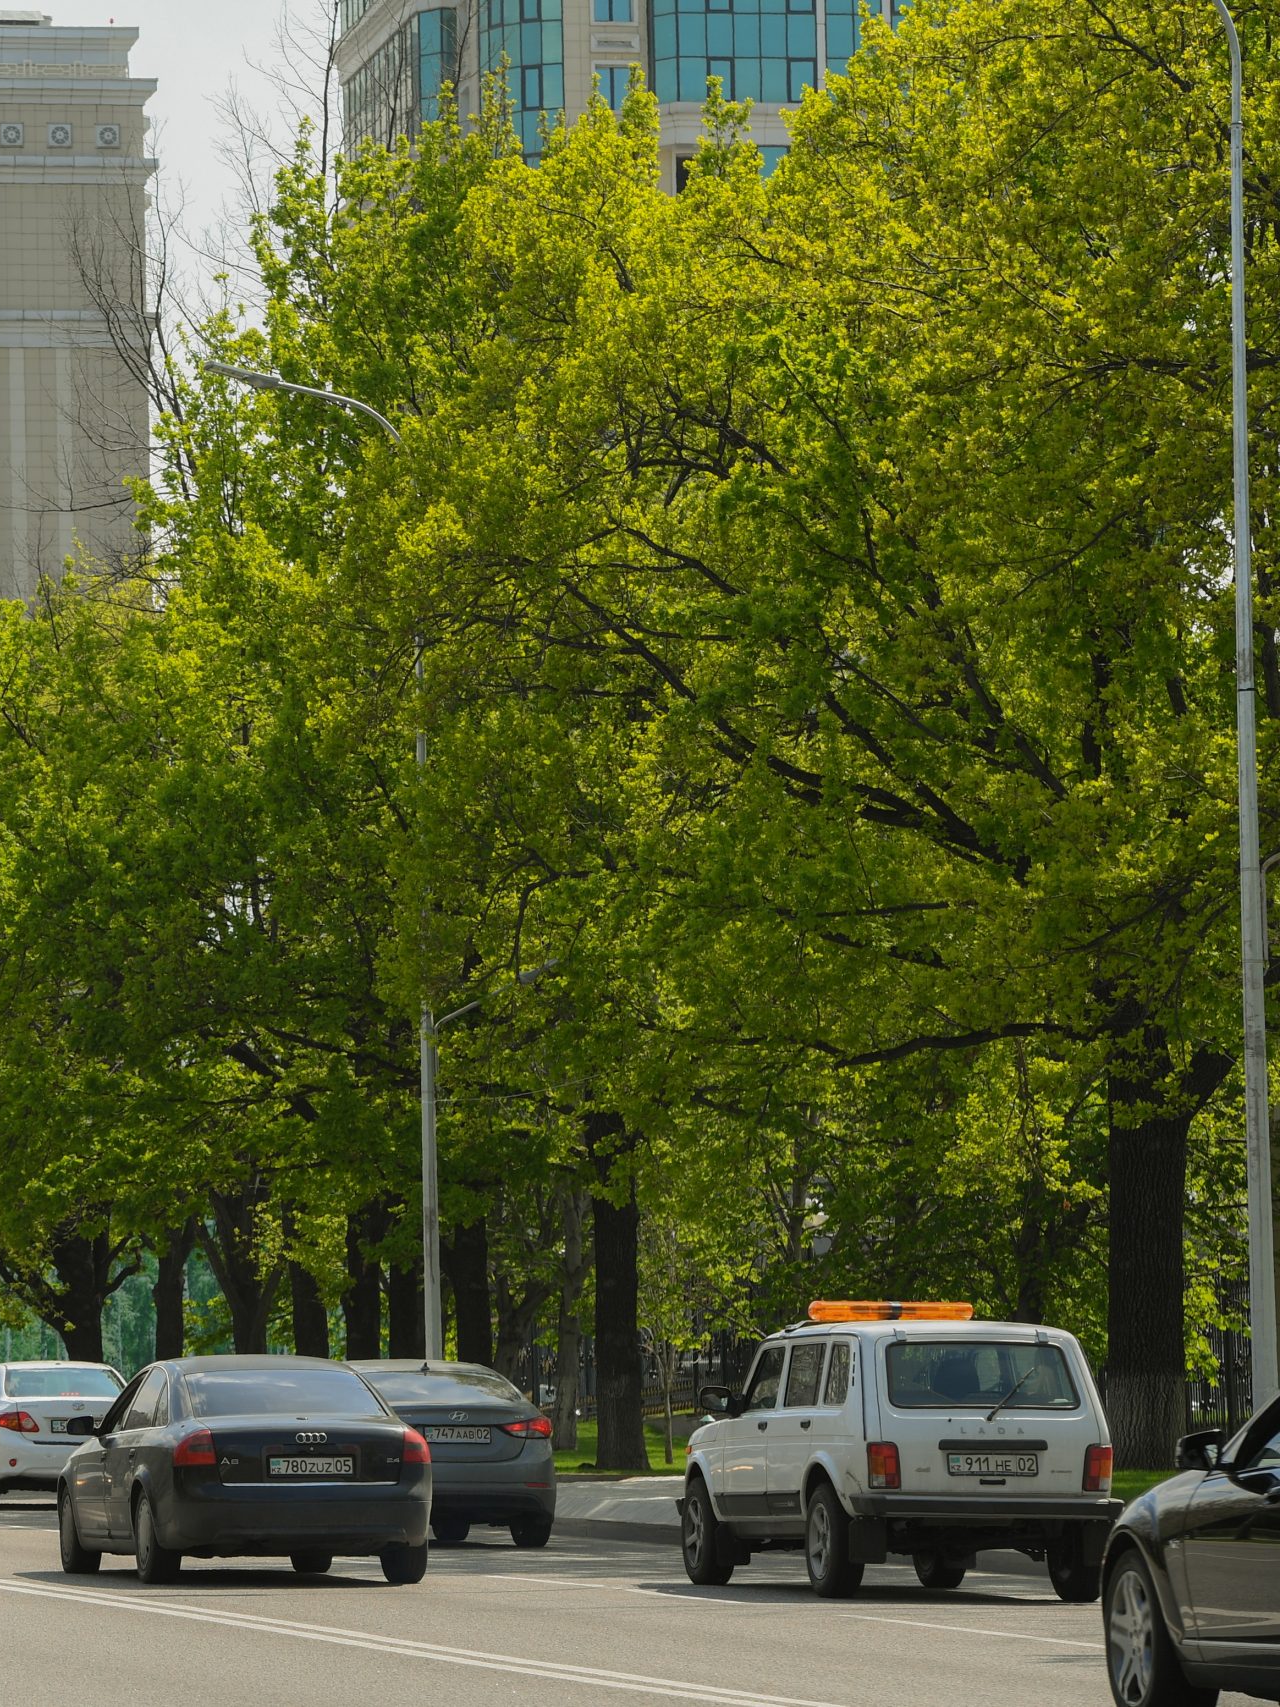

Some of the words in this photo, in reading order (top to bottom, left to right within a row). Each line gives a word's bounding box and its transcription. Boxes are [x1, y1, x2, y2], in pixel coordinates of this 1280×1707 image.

[434, 1428, 475, 1440] 747AAB
[476, 1429, 490, 1440] 02
[960, 1427, 1024, 1435] LADA
[282, 1459, 332, 1473] 780ZUZ
[335, 1459, 352, 1473] 05
[965, 1456, 990, 1471] 911
[995, 1460, 1012, 1471] HE
[1018, 1457, 1035, 1471] 02
